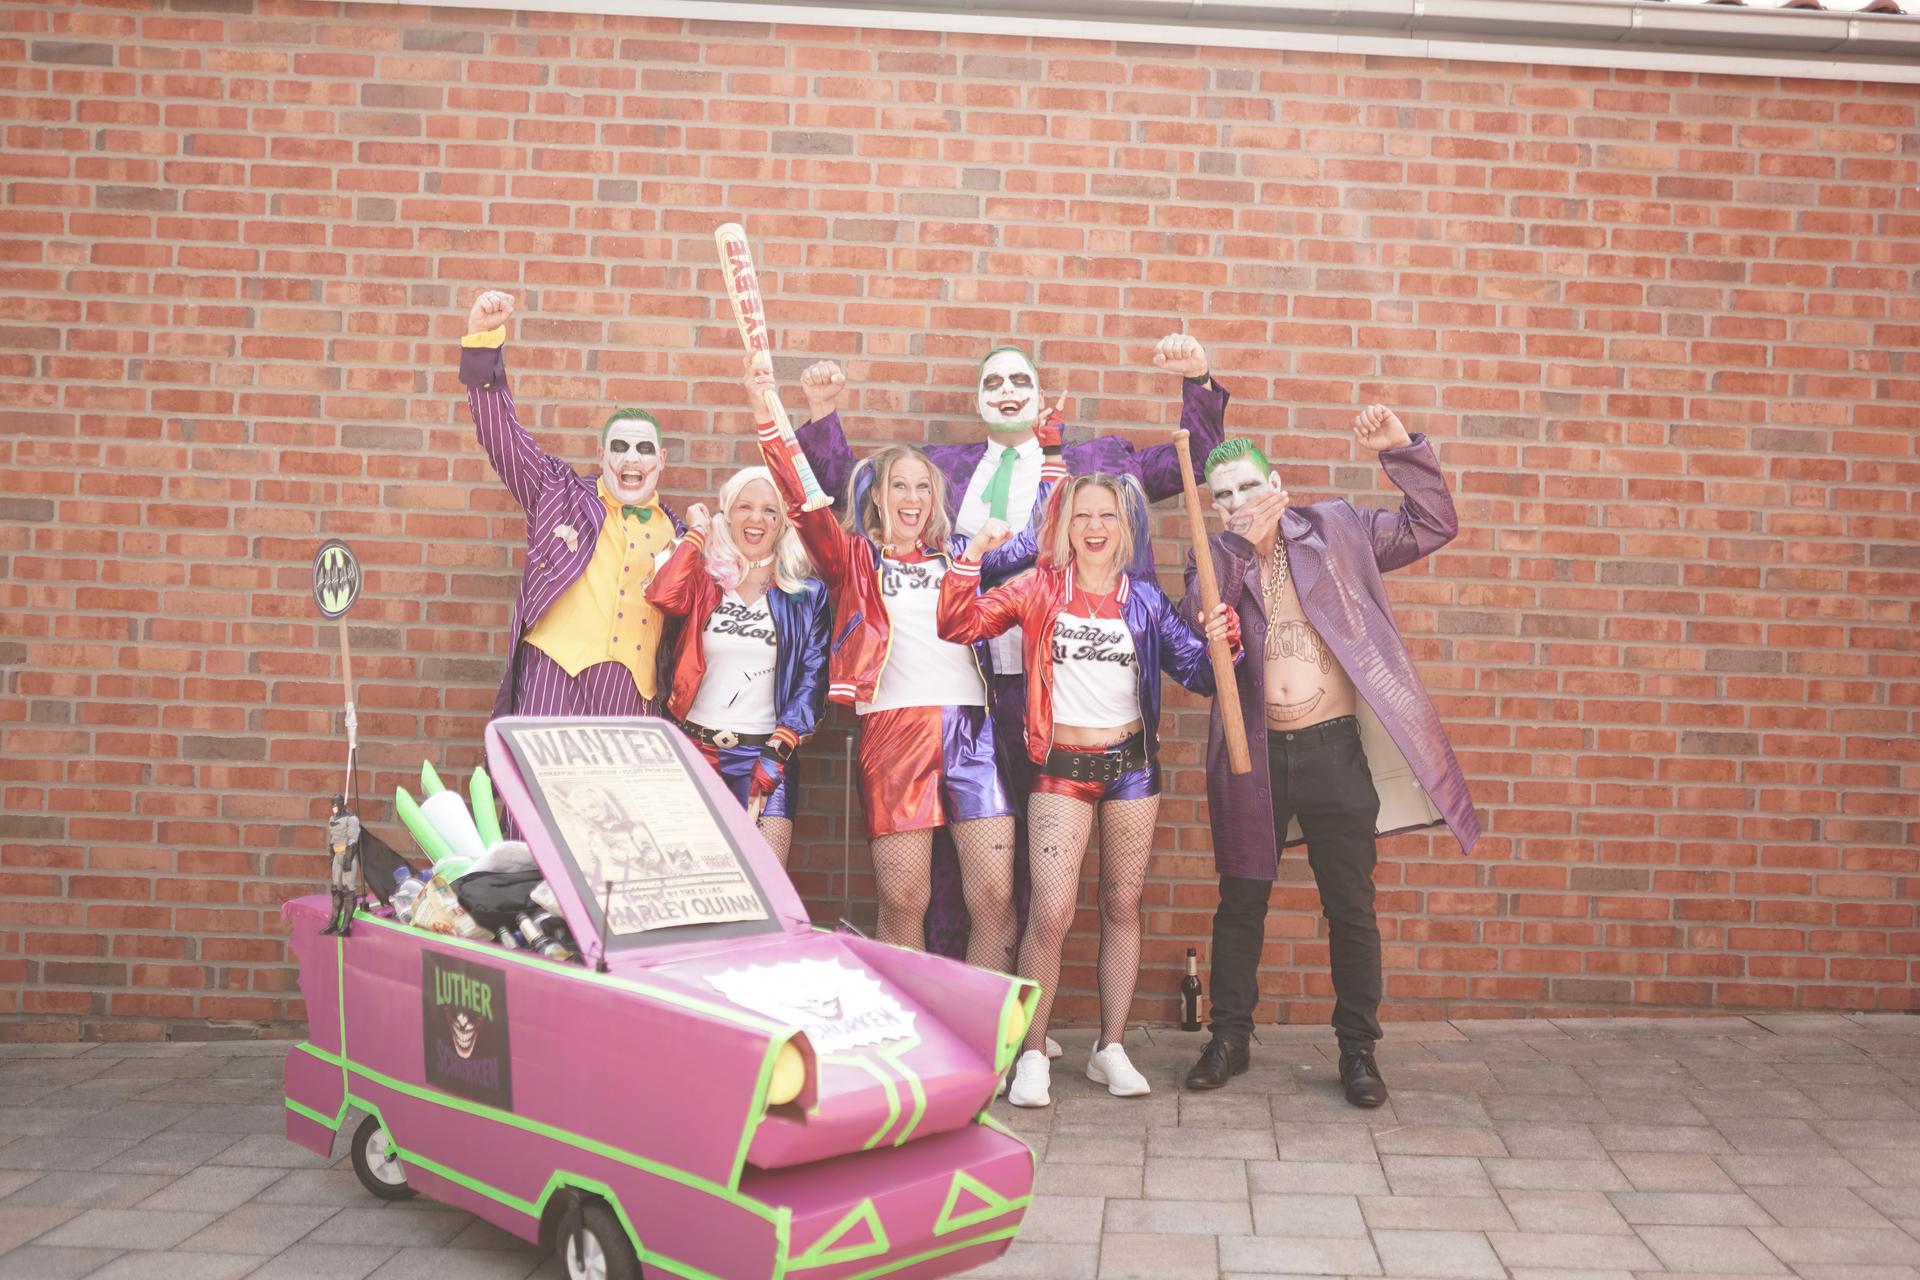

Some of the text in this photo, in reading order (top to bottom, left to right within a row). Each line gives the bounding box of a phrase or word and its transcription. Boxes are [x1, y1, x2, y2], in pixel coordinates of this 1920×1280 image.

[1265, 620, 1332, 675] KER
[519, 728, 677, 766] WANTED
[691, 894, 763, 916] QUINN
[434, 965, 493, 1021] LUTHER
